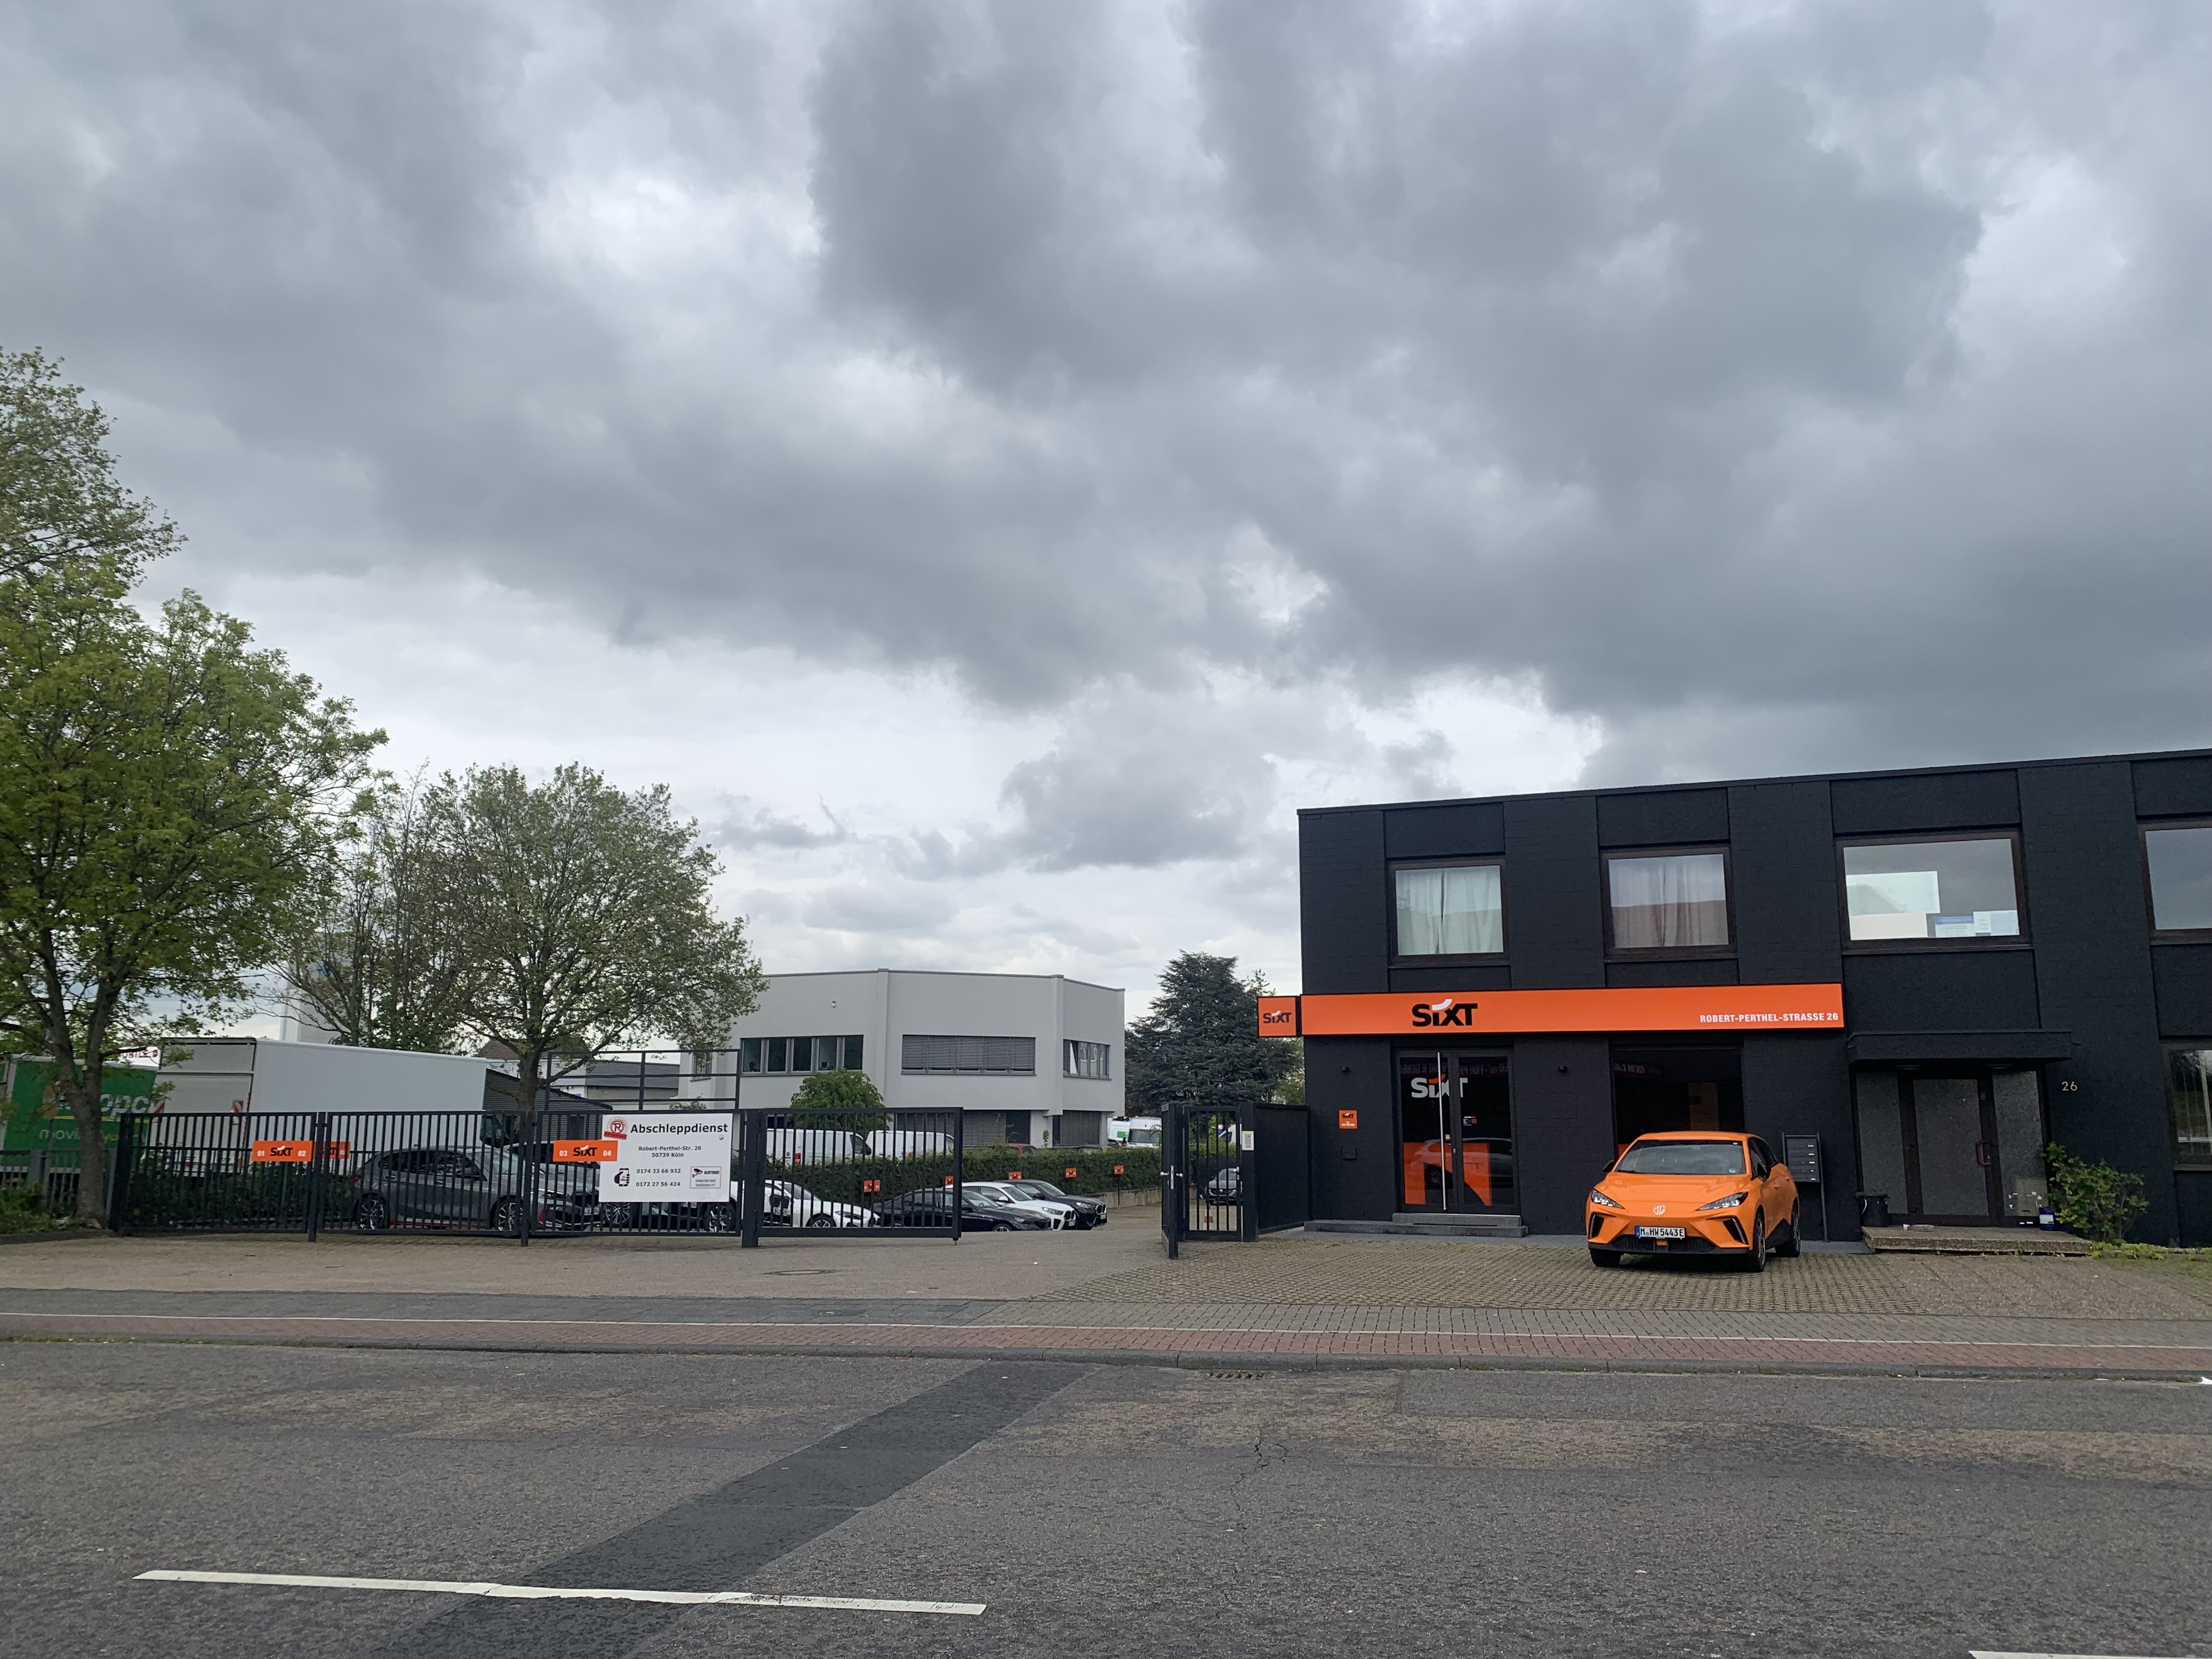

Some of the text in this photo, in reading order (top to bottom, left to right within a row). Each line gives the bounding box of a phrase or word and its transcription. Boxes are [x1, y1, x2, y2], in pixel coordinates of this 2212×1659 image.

[1263, 1010, 1291, 1024] SIXT
[1412, 998, 1478, 1027] SIXT
[1700, 1013, 1839, 1023] ROBERT-PERTHEL-STRASSE 26
[2062, 1081, 2078, 1091] 26
[630, 1124, 728, 1135] Abschleppdienst
[270, 1146, 293, 1156] SIXT
[573, 1146, 597, 1156] SIXT
